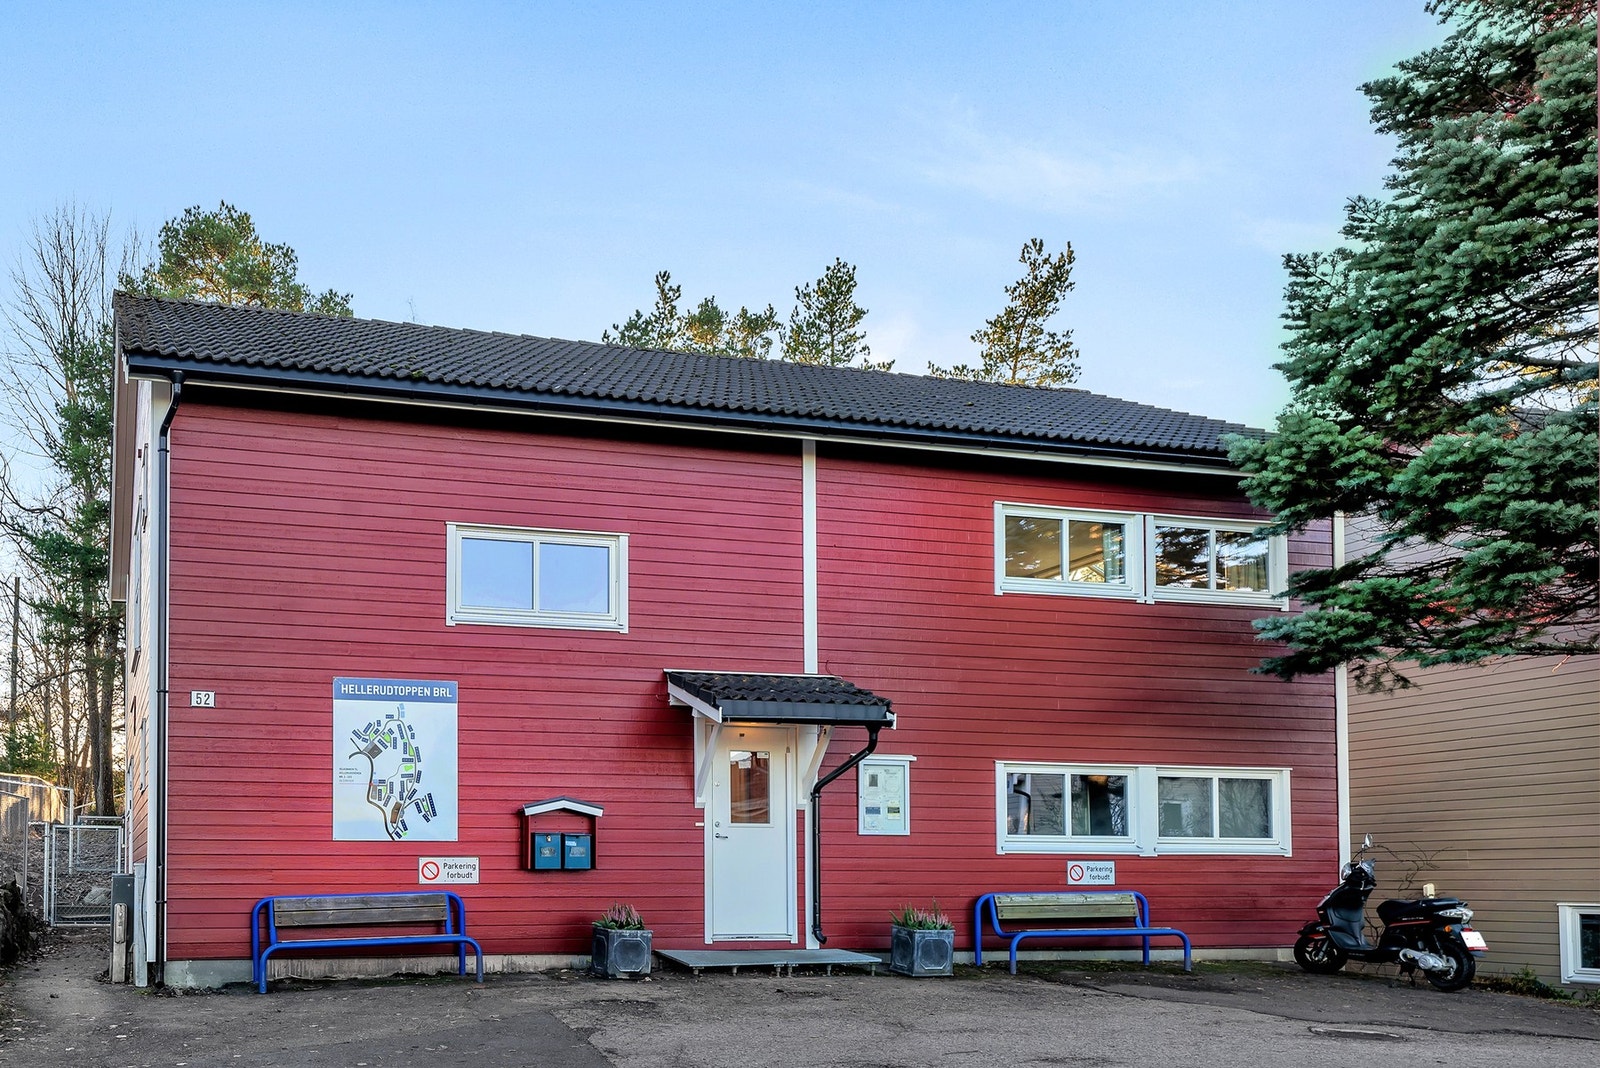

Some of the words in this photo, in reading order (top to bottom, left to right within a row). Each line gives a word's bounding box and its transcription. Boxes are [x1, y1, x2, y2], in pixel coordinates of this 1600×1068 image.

[341, 684, 431, 697] HELLERUDTOPPEN
[433, 687, 452, 698] BRL
[196, 692, 210, 705] 52
[443, 862, 477, 871] Parkering
[1086, 865, 1113, 874] Parkering
